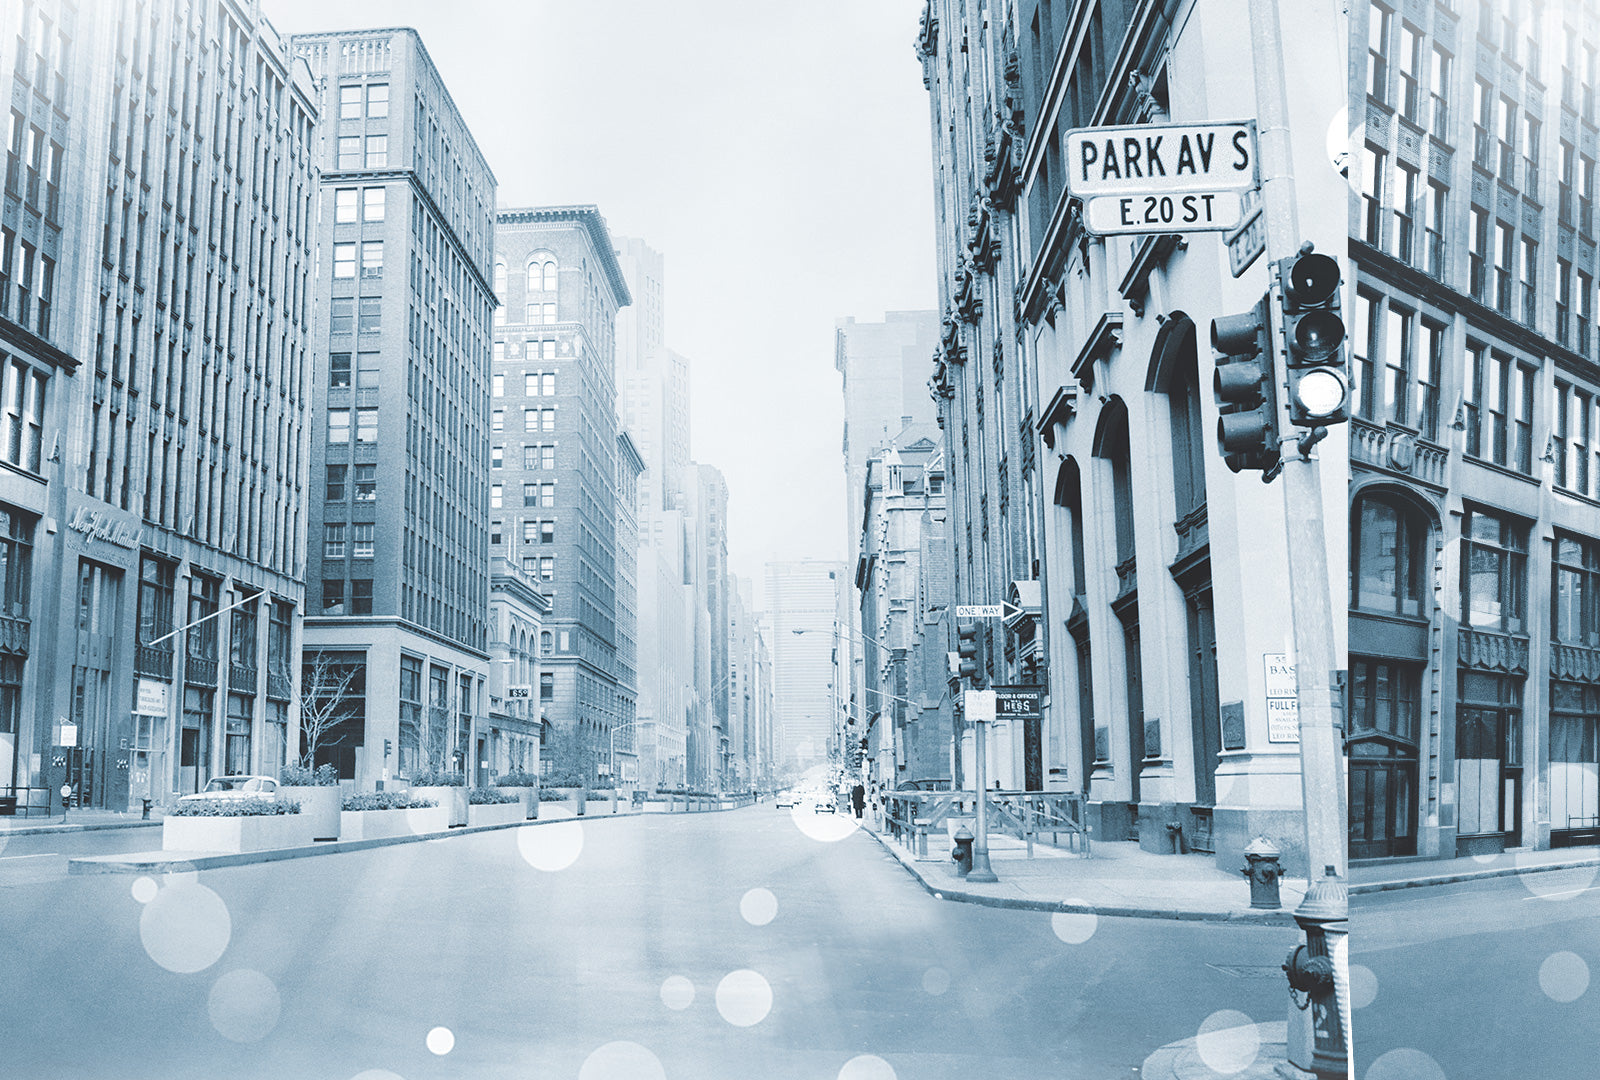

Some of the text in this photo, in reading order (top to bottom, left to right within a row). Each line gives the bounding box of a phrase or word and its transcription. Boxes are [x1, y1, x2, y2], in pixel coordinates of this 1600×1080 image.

[1080, 130, 1249, 182] PARK AV S
[1119, 194, 1215, 226] E.20 ST
[959, 607, 1000, 616] ONE WAY
[1003, 700, 1030, 711] HESS
[1270, 701, 1289, 710] FULL
